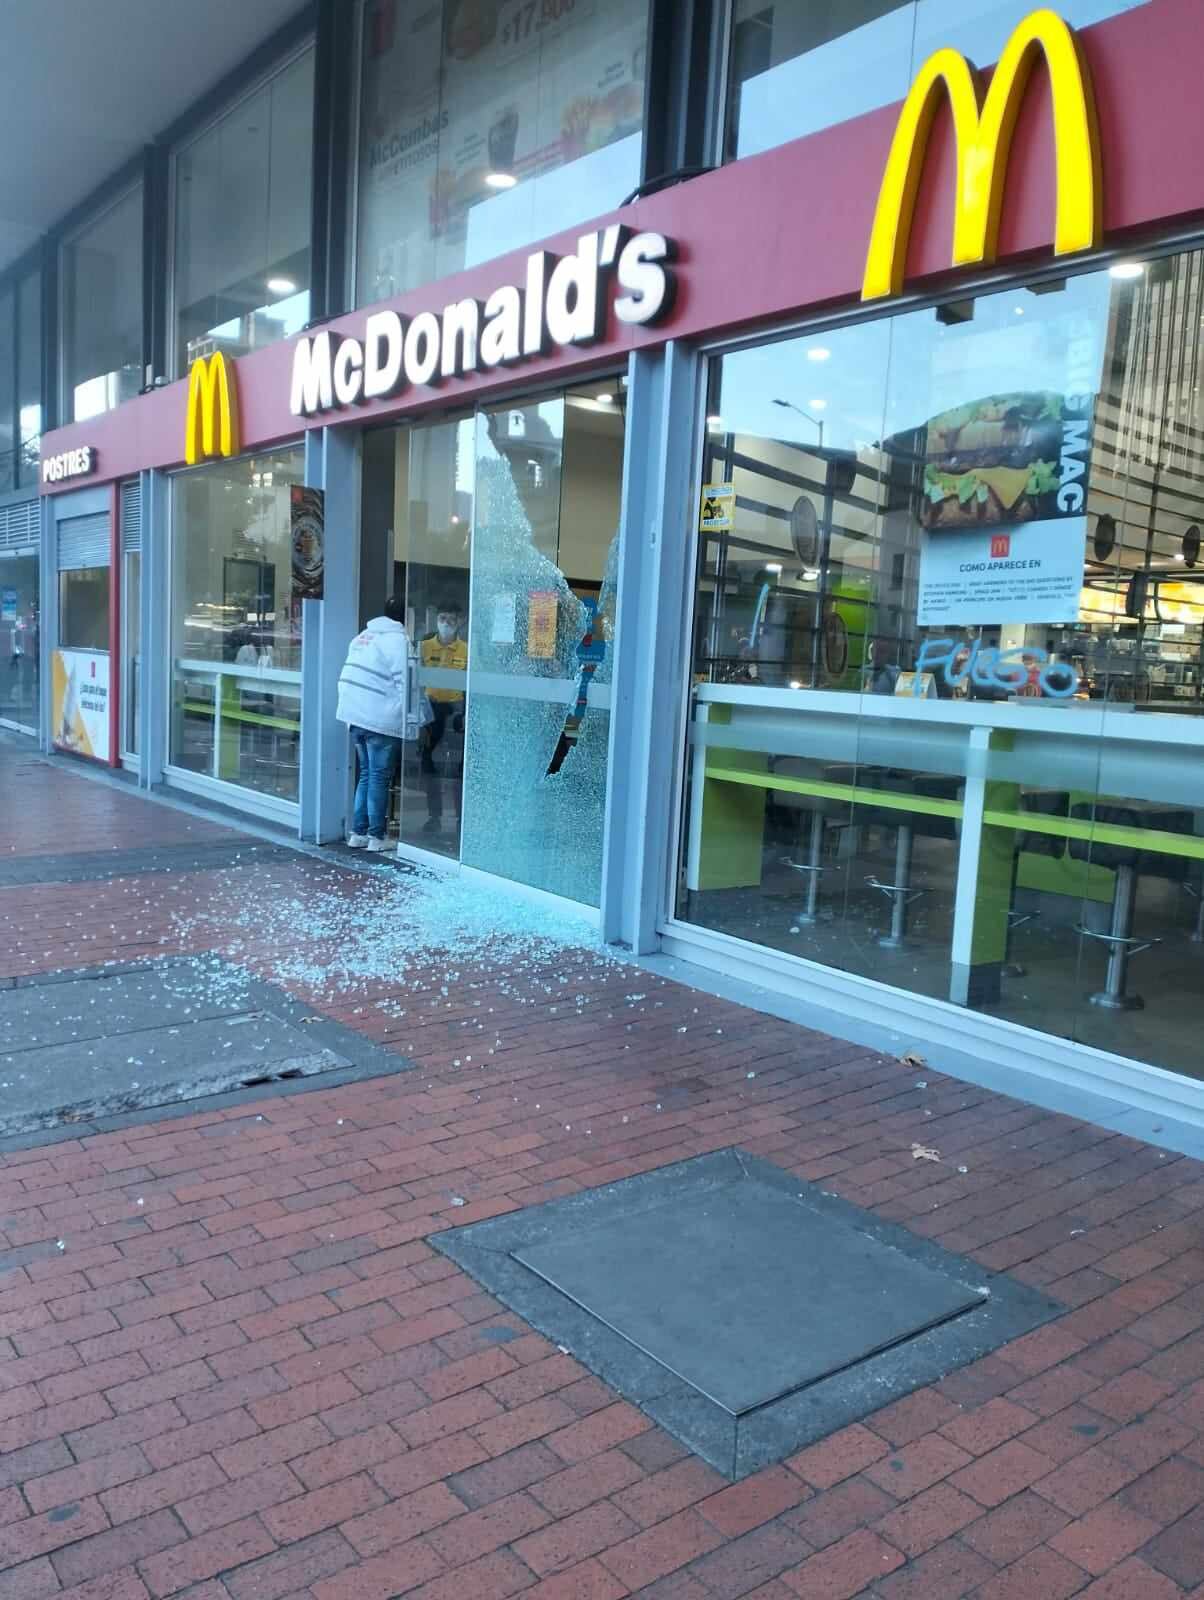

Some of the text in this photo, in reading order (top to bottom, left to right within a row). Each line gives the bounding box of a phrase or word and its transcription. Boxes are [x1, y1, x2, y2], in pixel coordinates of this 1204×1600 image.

[289, 223, 668, 416] McDonald's
[42, 446, 90, 483] POSTRES
[1056, 419, 1089, 513] MAC
[959, 559, 1041, 573] COMO APARECE EN
